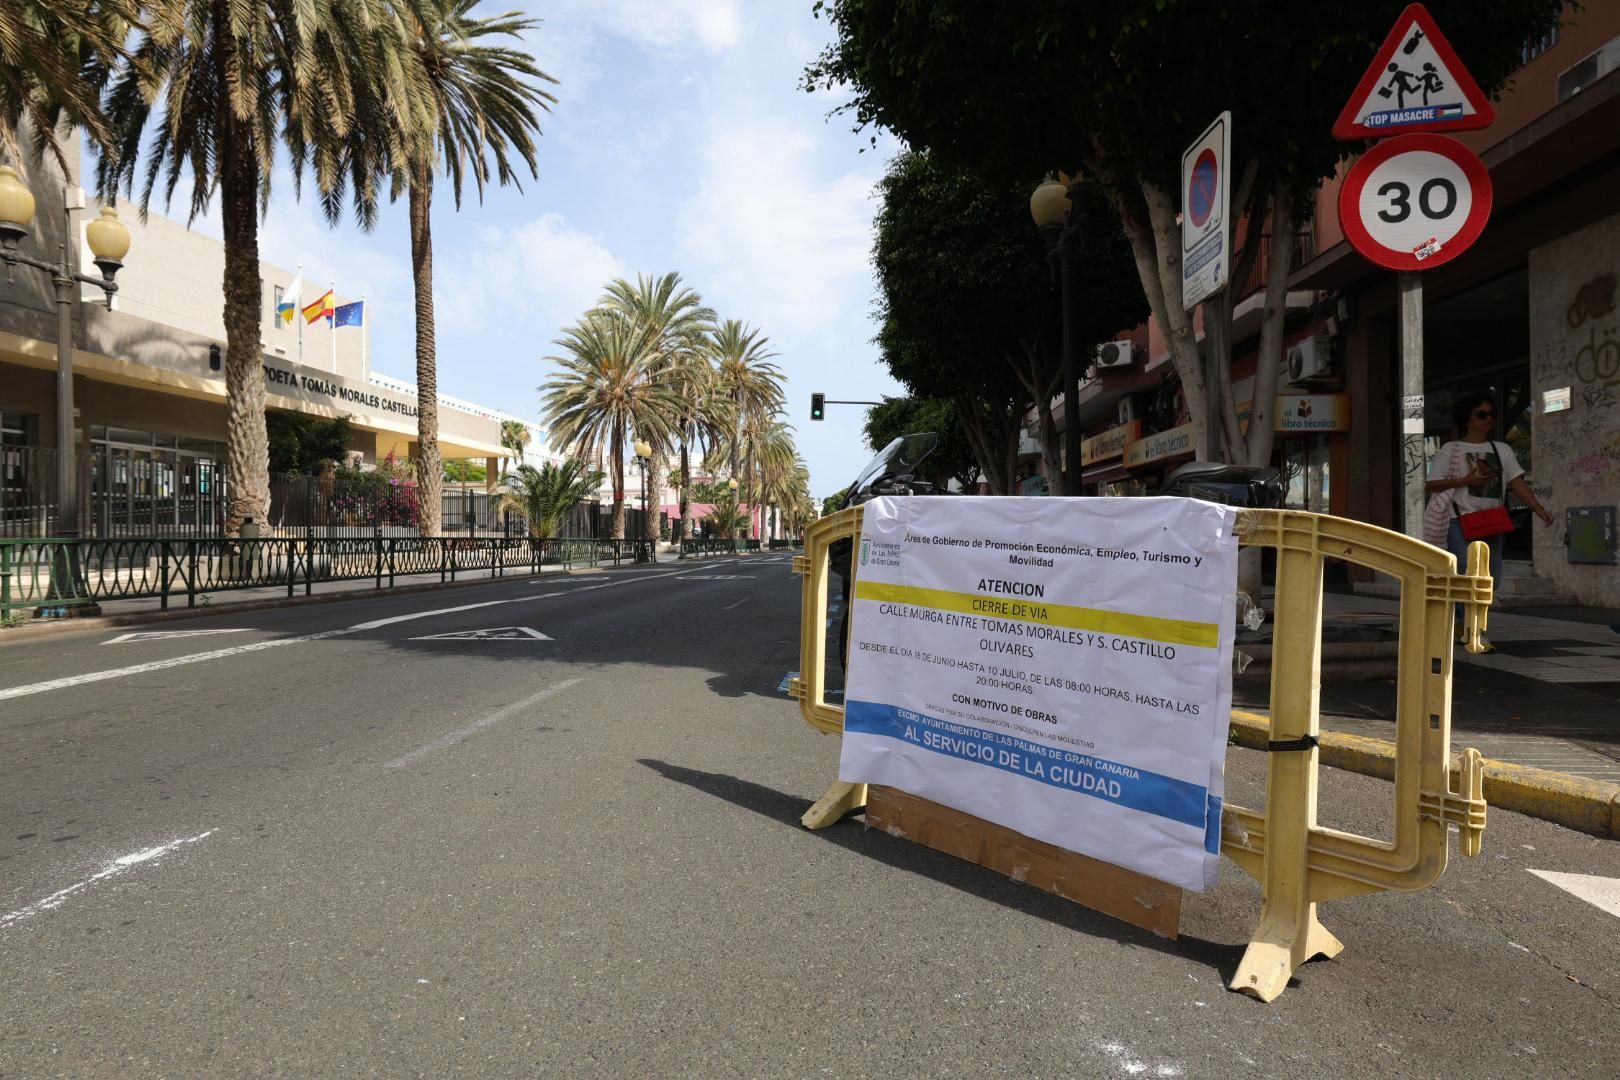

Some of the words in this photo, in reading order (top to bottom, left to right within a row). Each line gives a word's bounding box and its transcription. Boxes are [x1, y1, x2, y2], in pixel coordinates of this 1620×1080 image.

[1364, 114, 1387, 127] STOP
[1390, 109, 1434, 124] MASACRE
[1377, 177, 1458, 223] 30
[301, 376, 337, 398] TOMÁS
[339, 387, 380, 408] MORALES
[382, 398, 420, 418] CASTELLA
[1284, 408, 1292, 417] el
[1281, 418, 1302, 429] libro
[1304, 418, 1337, 429] técnico
[922, 535, 931, 544] de
[932, 536, 970, 548] Gobierno
[972, 538, 983, 548] de
[985, 541, 1034, 553] Promoción
[1036, 543, 1093, 558] Económica,
[1097, 548, 1139, 562] Empleo,
[1142, 550, 1190, 564] Turismo
[1194, 557, 1202, 567] y
[1010, 555, 1054, 567] Movilidad
[978, 579, 1044, 597] ATENCION
[972, 599, 1008, 615] CIERRE
[1012, 604, 1027, 616] DE
[1029, 606, 1048, 620] VIA
[880, 604, 907, 618] CALLE
[910, 609, 943, 624] MURGA
[946, 614, 978, 629] ENTRE
[981, 619, 1023, 635] TOMAS
[1026, 627, 1083, 645] MORALES
[1087, 635, 1094, 646] Y
[1097, 636, 1108, 649] S.
[1112, 639, 1176, 660] CASTILLO
[980, 638, 1034, 658] OLIVARES
[860, 642, 888, 654] DESDE
[889, 646, 900, 655] EL
[922, 652, 932, 663] DE
[933, 656, 956, 668] JUNIO
[957, 660, 985, 673] HASTA
[988, 666, 998, 676] 10
[1000, 668, 1028, 682] JULIO,
[1030, 673, 1042, 684] DE
[1044, 676, 1063, 688] LAS
[1065, 680, 1091, 694] 08:00
[1094, 686, 1133, 703] HORAS,
[1135, 694, 1174, 710] HASTA
[1176, 701, 1200, 715] LAS
[976, 676, 999, 688] 20:00
[1001, 681, 1033, 695] HORAS
[952, 693, 971, 705] CON
[973, 698, 1008, 713] MOTIVO
[1011, 705, 1023, 716] DE
[1025, 709, 1058, 725] OBRAS
[897, 709, 919, 722] EXCMO
[922, 714, 980, 738] AYUNTAMIENTO
[983, 732, 994, 741] DE
[996, 735, 1012, 746] LAS
[1014, 740, 1047, 757] PALMAS
[1049, 750, 1062, 761] DE
[1065, 753, 1093, 768] GRAN
[1095, 760, 1140, 780] CANARIA
[1044, 732, 1057, 741] LAS
[1057, 735, 1095, 749] MOLESTIAS
[904, 725, 920, 743] AL
[923, 731, 994, 761] SERVICIO
[999, 750, 1020, 769] DE
[1025, 757, 1045, 779] LA
[1050, 765, 1121, 799] CIUDAD
